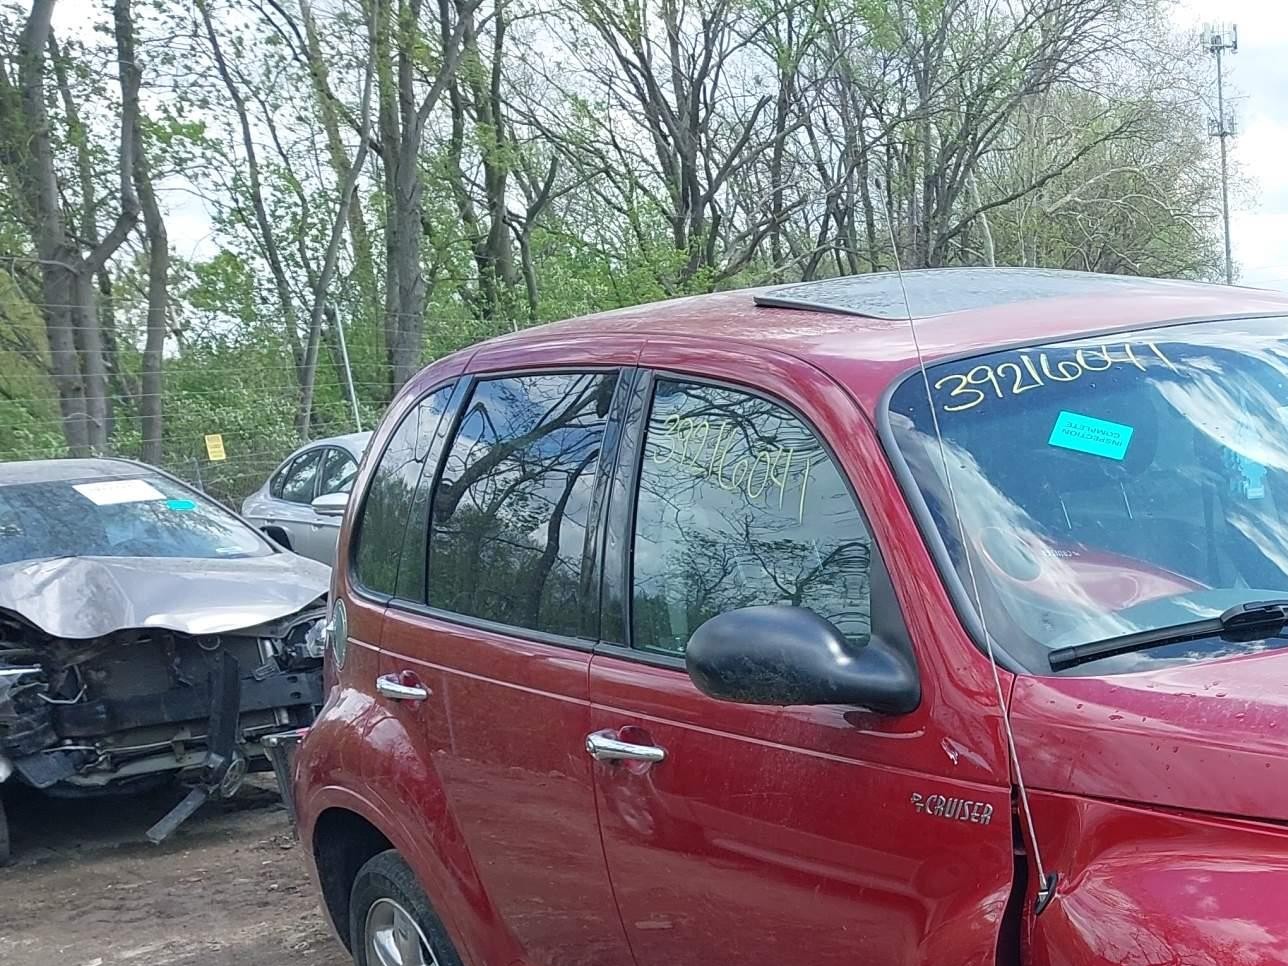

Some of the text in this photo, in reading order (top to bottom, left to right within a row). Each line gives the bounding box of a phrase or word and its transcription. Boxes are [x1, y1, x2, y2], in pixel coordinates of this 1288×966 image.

[934, 342, 1181, 412] 39216041
[1061, 428, 1123, 447] INSPECTION
[1065, 421, 1121, 439] COMPLETE
[653, 413, 811, 524] 39216041
[926, 794, 994, 825] CRUISER
